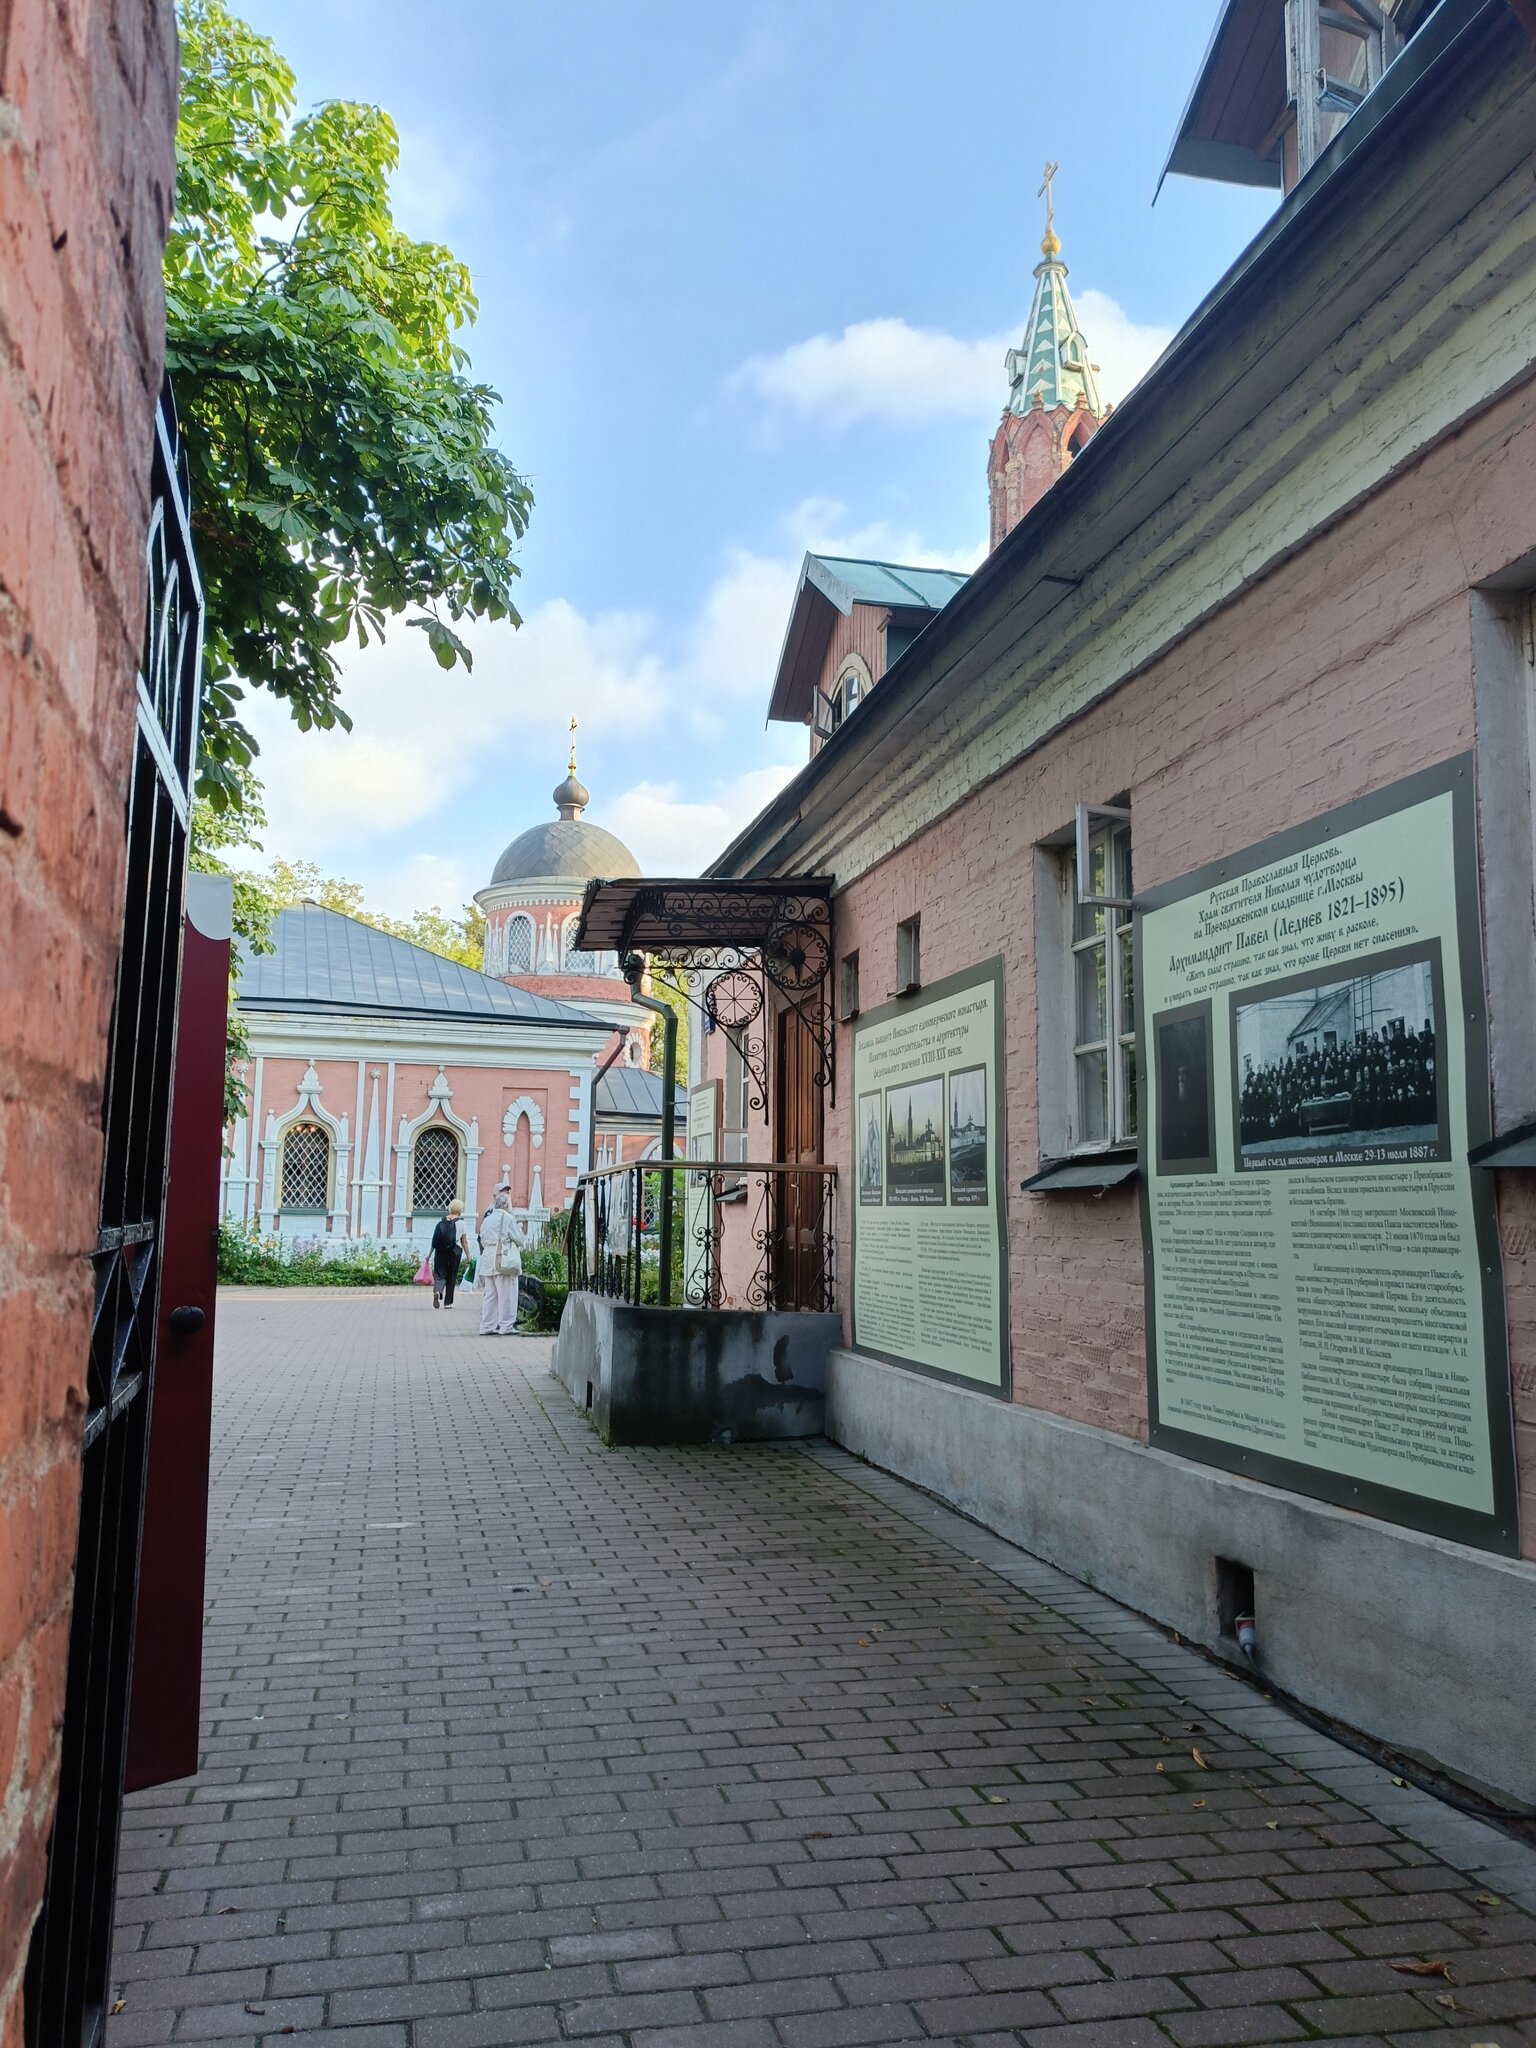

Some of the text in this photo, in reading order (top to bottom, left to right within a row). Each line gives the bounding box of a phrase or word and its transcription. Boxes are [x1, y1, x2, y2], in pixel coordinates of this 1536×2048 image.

[1209, 846, 1342, 905] Русская Православная Церковь.
[1198, 856, 1357, 926] Храм святителя Николая чудотворца
[1193, 929, 1202, 939] на
[1204, 905, 1268, 936] Преображенском
[1270, 884, 1314, 912] кладбище
[1168, 940, 1232, 974] Архимандрит
[1235, 929, 1268, 950] Павел
[1273, 911, 1322, 941] (Леднев
[1207, 964, 1221, 975] было
[1223, 956, 1251, 971] страшно,
[1254, 951, 1265, 961] так
[1267, 947, 1279, 957] как
[1280, 942, 1298, 954] знал,
[1300, 936, 1314, 947] что
[1315, 929, 1336, 943] живу
[1345, 917, 1378, 937] расколе,
[1168, 989, 1192, 1002] умирать
[1193, 984, 1207, 994] было
[1208, 976, 1235, 991] страшно,
[1237, 972, 1249, 981] так
[1250, 968, 1262, 978] как
[1263, 963, 1281, 975] знал,
[1283, 958, 1296, 968] что
[1298, 952, 1319, 966] кроме
[1321, 943, 1351, 959] Церкви
[1353, 937, 1369, 949] нет
[892, 1023, 917, 1039] Никольского
[919, 1009, 955, 1030] единоверческого
[957, 998, 988, 1016] монастыря.
[888, 1036, 930, 1057] градостроительства
[936, 1024, 968, 1044] архитектуры
[947, 1045, 962, 1057] веков.
[1243, 1145, 1437, 1169] Первый съезд миссионеров в Москве 29-13 июля 1887 г.
[1413, 1170, 1453, 1181] Преображен-
[1428, 1182, 1455, 1193] Пруссии
[1437, 1207, 1456, 1216] Инно-
[1439, 1219, 1458, 1229] Нико-
[1446, 1231, 1460, 1241] был
[1421, 1246, 1461, 1256] архимандри-
[1430, 1268, 1450, 1278] Павел
[1449, 1269, 1463, 1279] объ-
[1426, 1282, 1464, 1294] старообряд-
[1425, 1295, 1466, 1305] деятельность
[1430, 1306, 1467, 1318] объединяла
[1424, 1319, 1467, 1331] многовековой
[1436, 1334, 1462, 1344] иерархи
[1424, 1367, 1443, 1379] Павла
[1450, 1371, 1468, 1383] Нико-
[1434, 1384, 1470, 1396] уникальная
[1436, 1394, 1470, 1409] бесценных
[1436, 1409, 1472, 1422] революции
[1453, 1435, 1472, 1448] Похо-
[1448, 1449, 1474, 1462] алтарем
[1458, 1464, 1475, 1475] клад-
